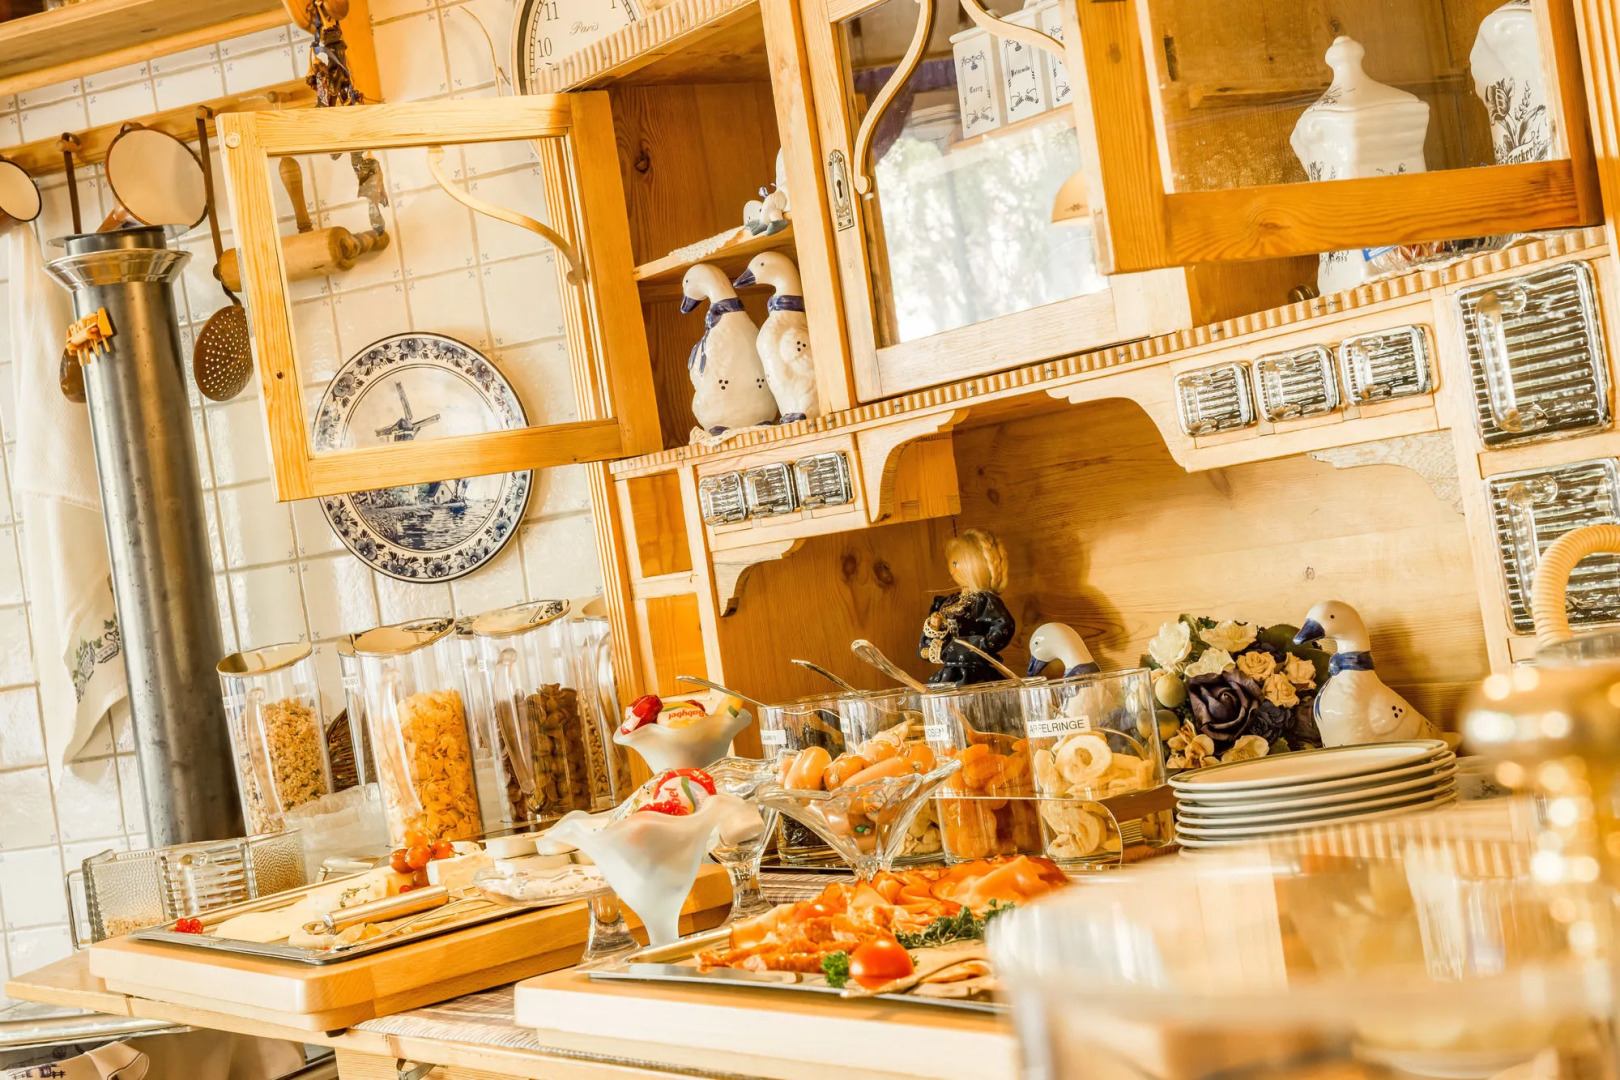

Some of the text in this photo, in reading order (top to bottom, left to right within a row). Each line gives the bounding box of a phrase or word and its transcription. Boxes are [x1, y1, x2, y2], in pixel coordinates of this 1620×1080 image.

[544, 0, 560, 21] 11
[570, 21, 599, 35] Paris
[537, 37, 552, 58] 10
[668, 709, 705, 720] Babybel
